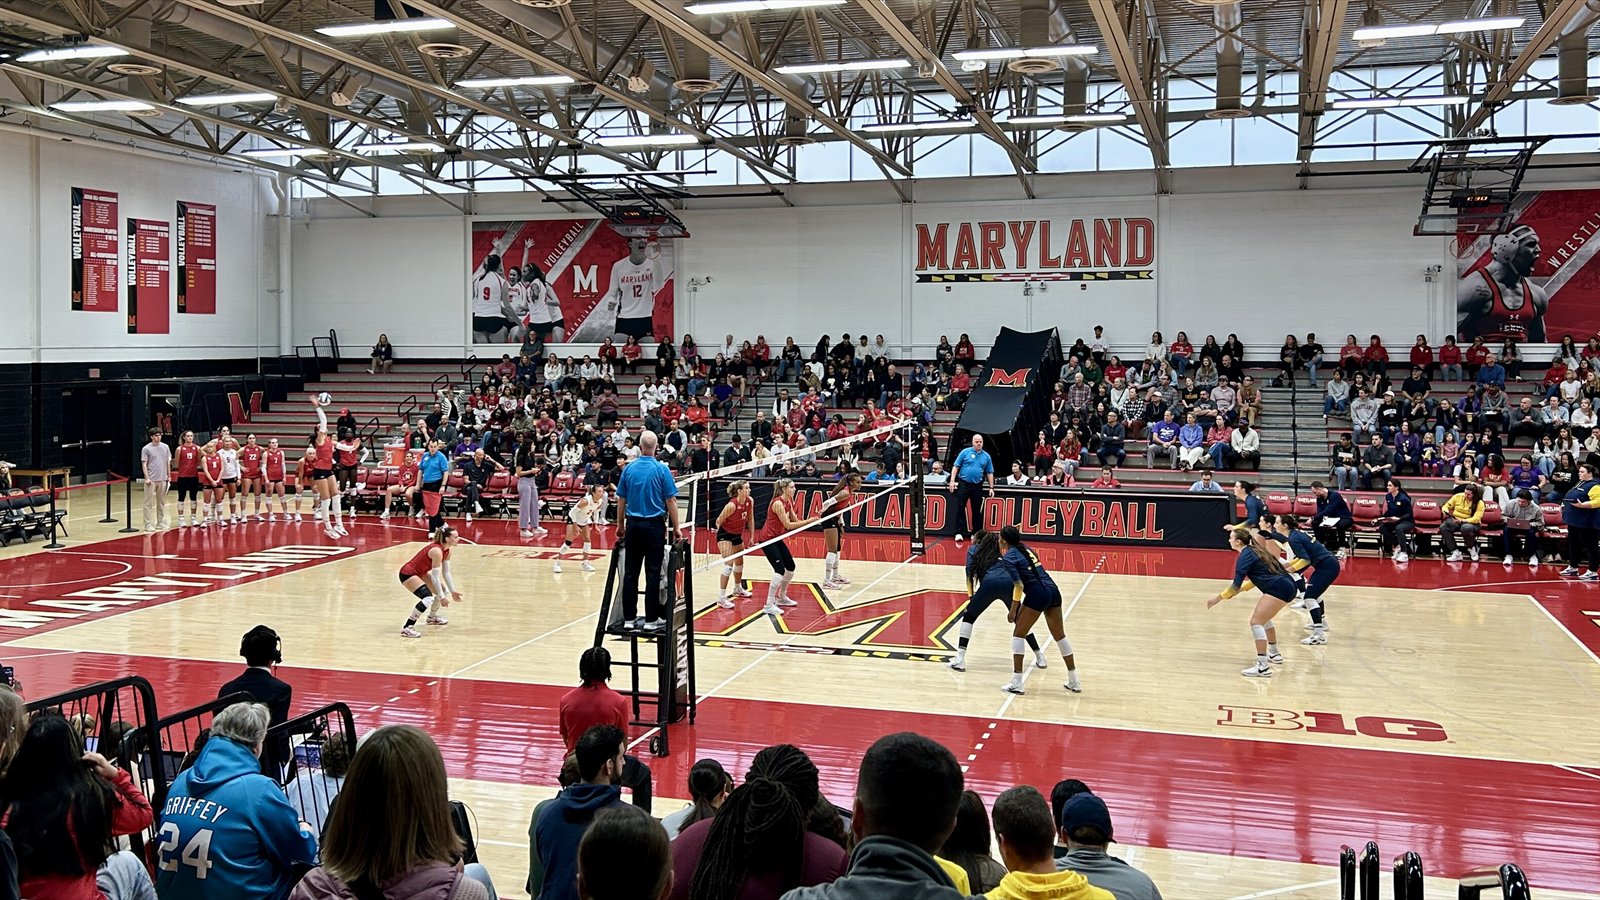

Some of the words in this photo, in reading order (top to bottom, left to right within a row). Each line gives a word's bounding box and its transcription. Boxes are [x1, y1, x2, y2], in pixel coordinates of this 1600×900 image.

[72, 204, 81, 260] VOLLEYBALL
[178, 216, 186, 267] VOLLEYBALL
[543, 220, 585, 268] VOLLEYBALL
[915, 217, 1155, 271] MARYLAND
[127, 233, 137, 286] VOLLEYBALL
[483, 286, 491, 301] 9
[572, 264, 599, 294] M
[632, 284, 643, 298] 12
[566, 299, 598, 337] MARYLAND
[987, 367, 1032, 385] M
[156, 412, 173, 436] M
[227, 391, 264, 425] M
[966, 494, 1164, 541] OLLEYBALL
[0, 544, 356, 630] MARYLAND
[1216, 704, 1448, 742] B1G
[165, 796, 229, 823] GRIFFEY
[157, 821, 214, 880] 24
